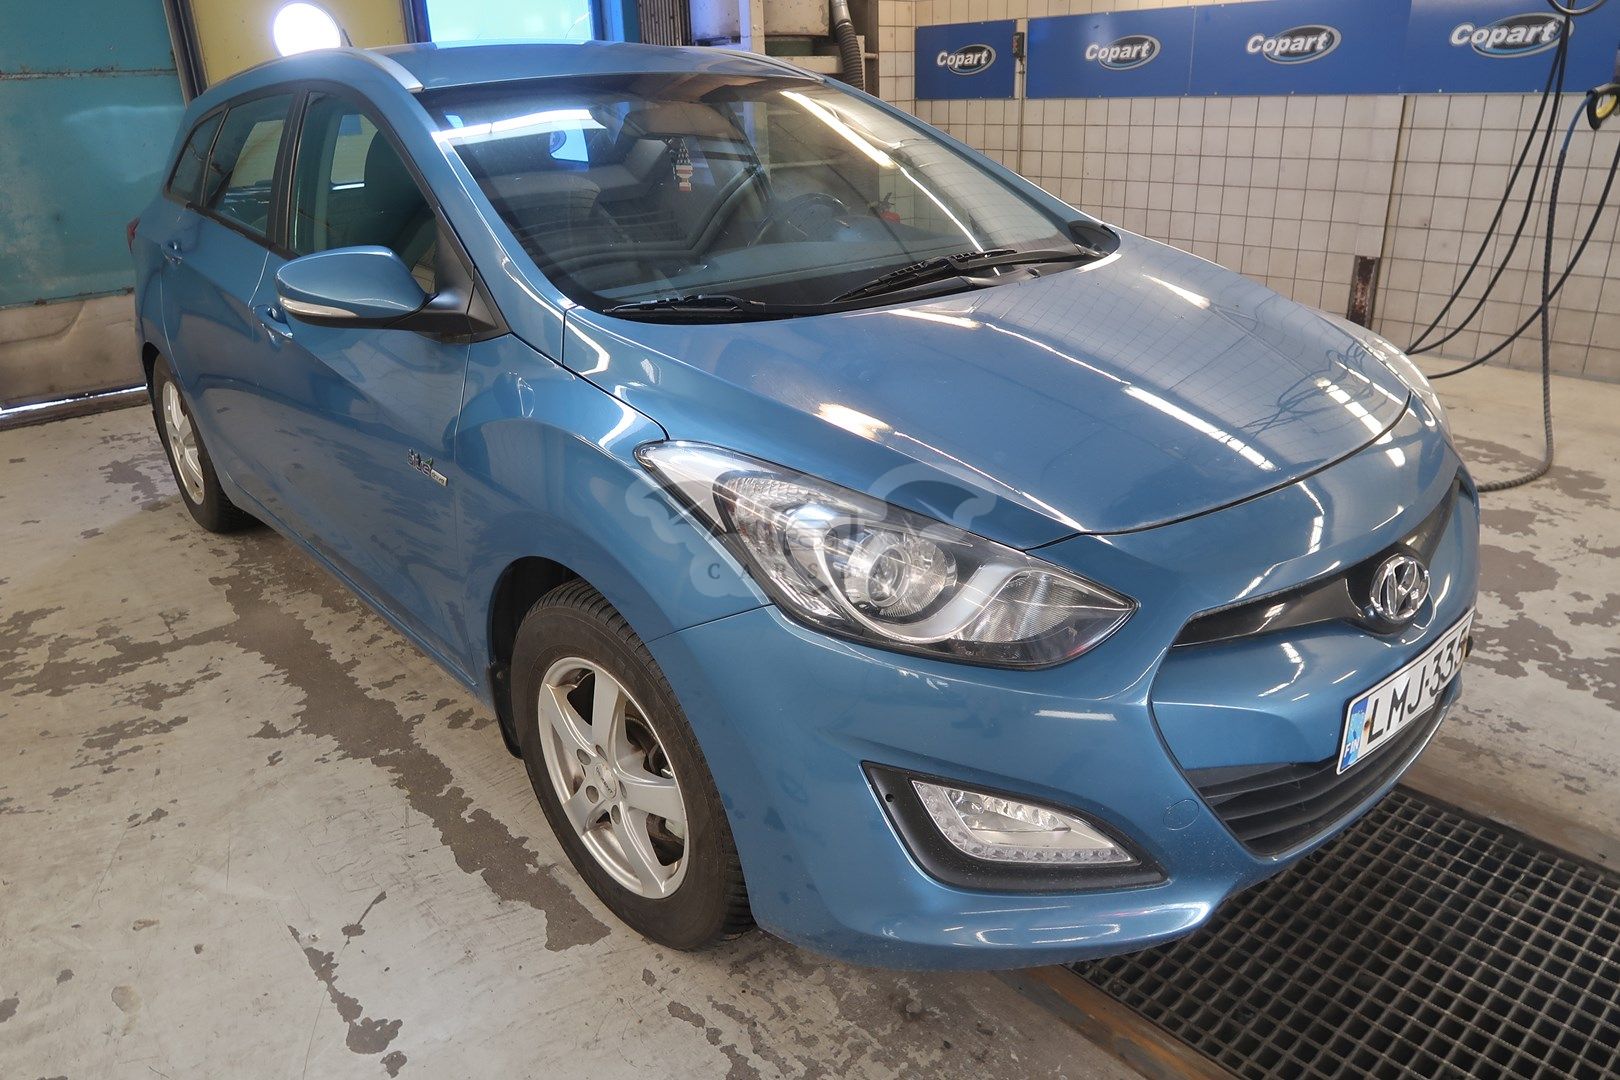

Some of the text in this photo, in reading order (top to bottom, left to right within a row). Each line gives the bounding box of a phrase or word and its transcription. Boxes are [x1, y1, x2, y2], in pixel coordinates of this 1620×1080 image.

[1247, 29, 1329, 57] Copart
[1451, 20, 1559, 49] Copart
[936, 50, 988, 68] Copart
[1085, 41, 1150, 63] Copart
